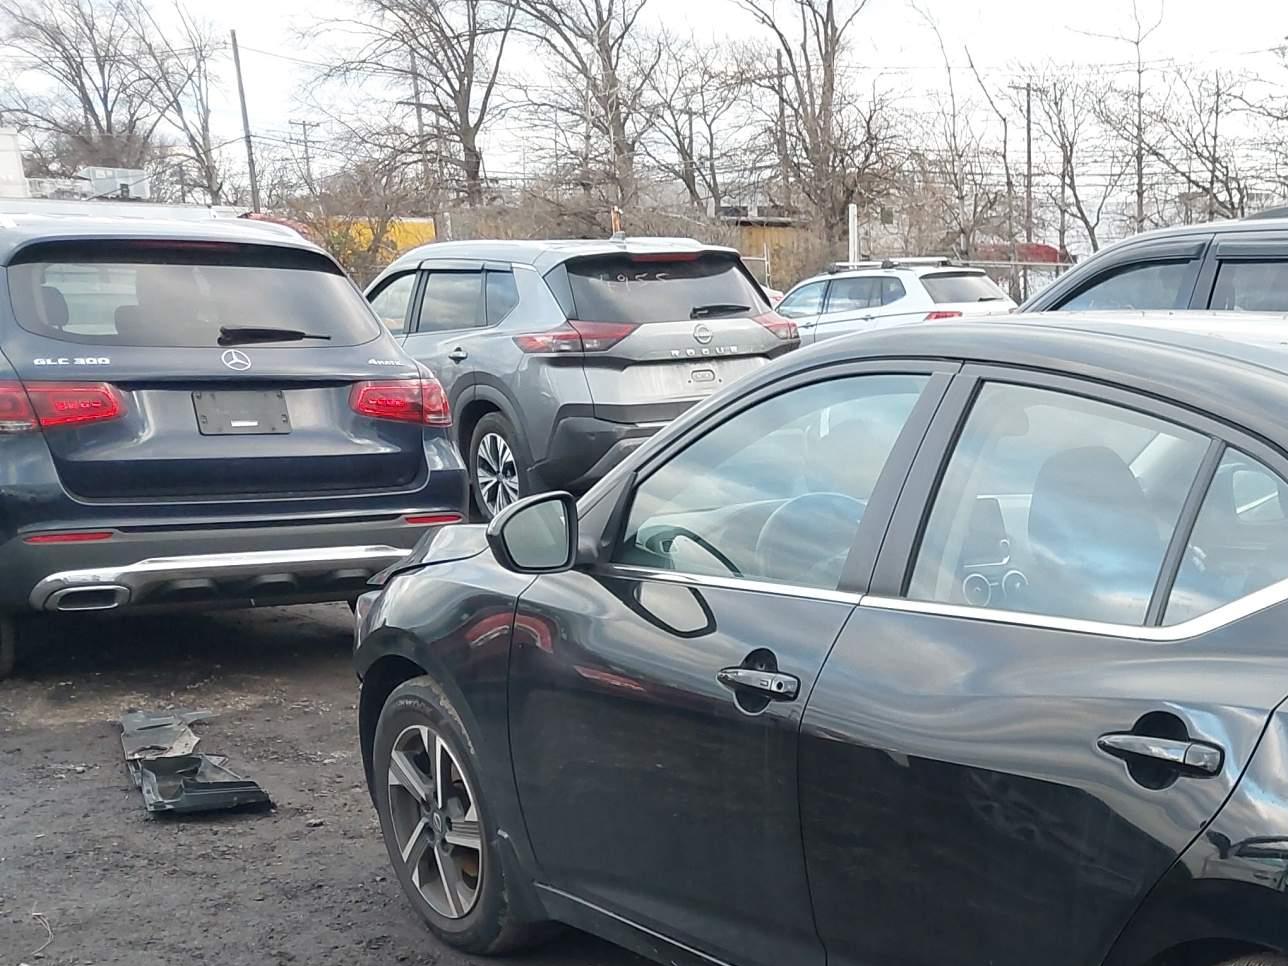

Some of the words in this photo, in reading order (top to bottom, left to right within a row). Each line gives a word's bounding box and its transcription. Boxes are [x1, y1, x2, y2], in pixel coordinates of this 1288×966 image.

[671, 345, 738, 357] ROGUE
[33, 357, 69, 366] GLC
[73, 356, 111, 365] 300
